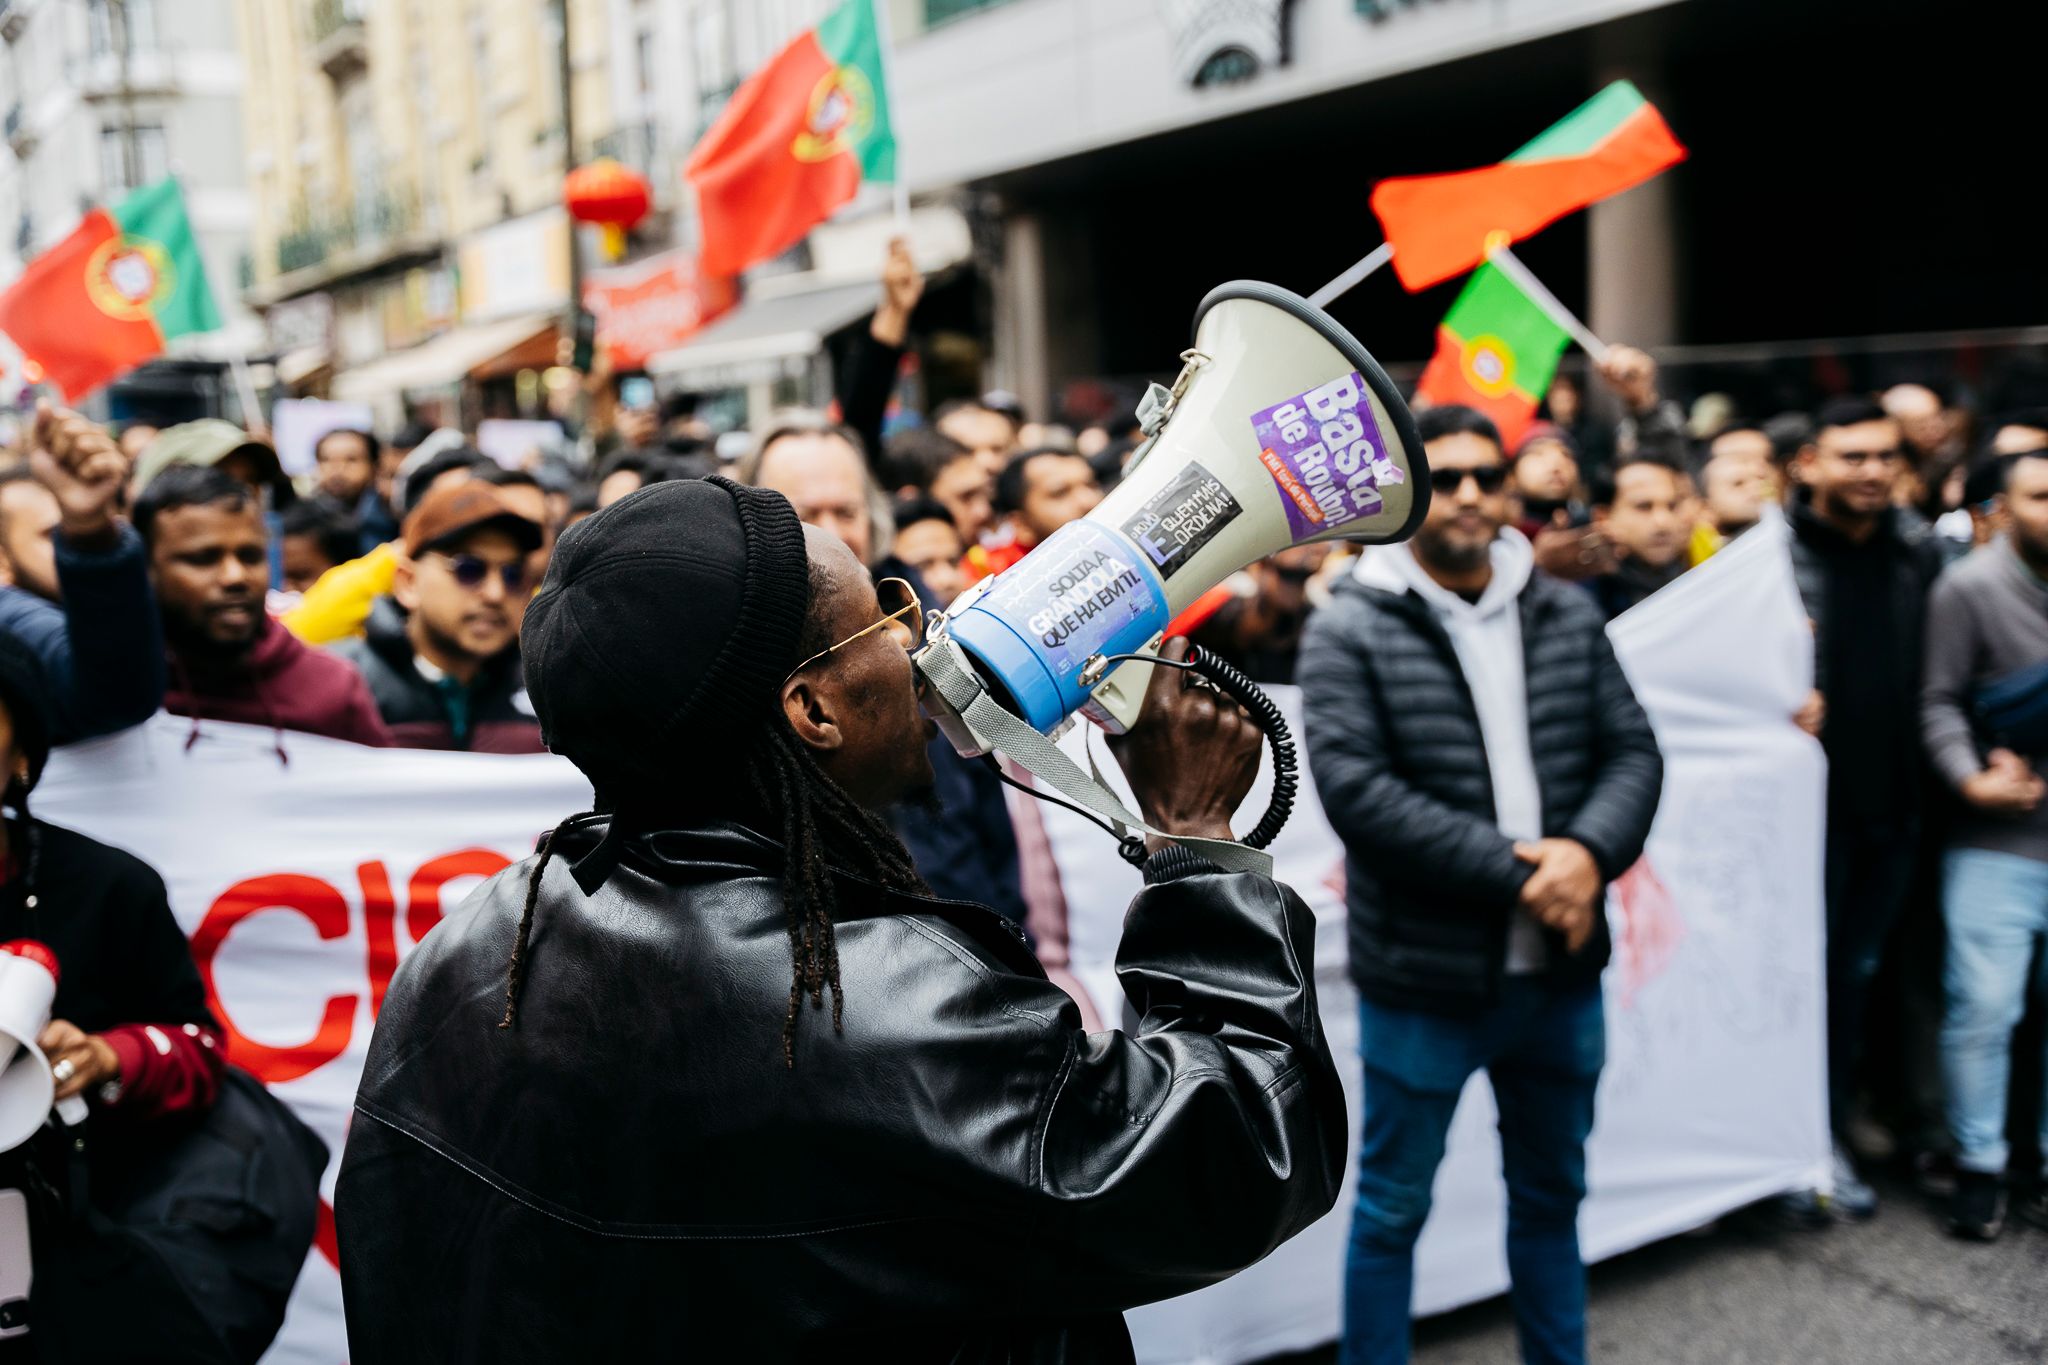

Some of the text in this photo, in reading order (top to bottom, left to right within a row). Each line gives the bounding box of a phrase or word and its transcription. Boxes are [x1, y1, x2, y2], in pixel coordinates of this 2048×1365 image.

[1272, 403, 1356, 528] de Roubo!
[1303, 374, 1382, 510] Basta
[1174, 491, 1233, 546] ORDENA!
[1042, 614, 1079, 649] QUE
[1096, 579, 1126, 608] EM
[1118, 569, 1141, 588] TI.
[1049, 550, 1111, 598] SOLTA A
